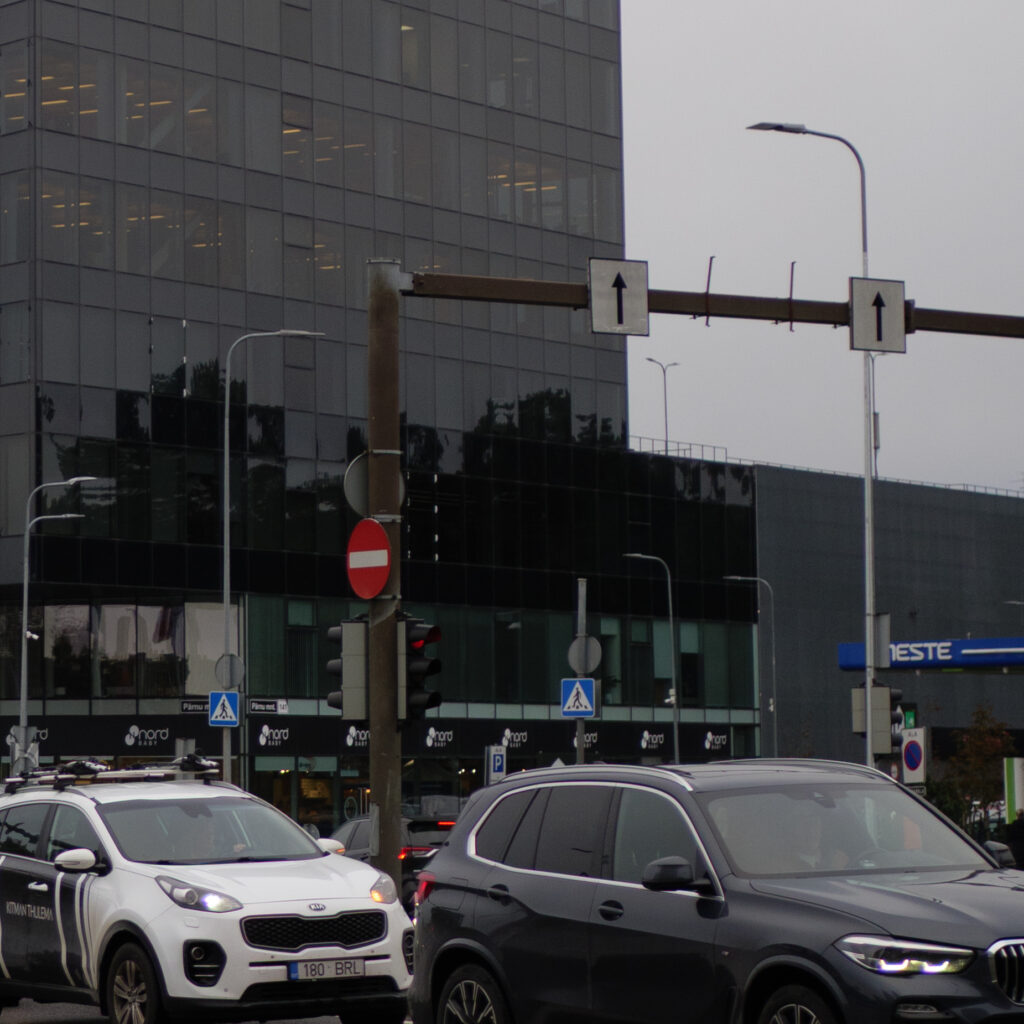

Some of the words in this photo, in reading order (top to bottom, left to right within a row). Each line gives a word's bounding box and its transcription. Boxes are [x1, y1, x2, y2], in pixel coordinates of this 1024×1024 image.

[138, 728, 169, 740] nord
[268, 728, 289, 740] nord
[434, 730, 453, 742] nord
[509, 731, 527, 742] nord
[648, 733, 664, 744] nord
[711, 734, 727, 745] nord
[303, 963, 325, 976] 180
[335, 961, 361, 976] BRL
